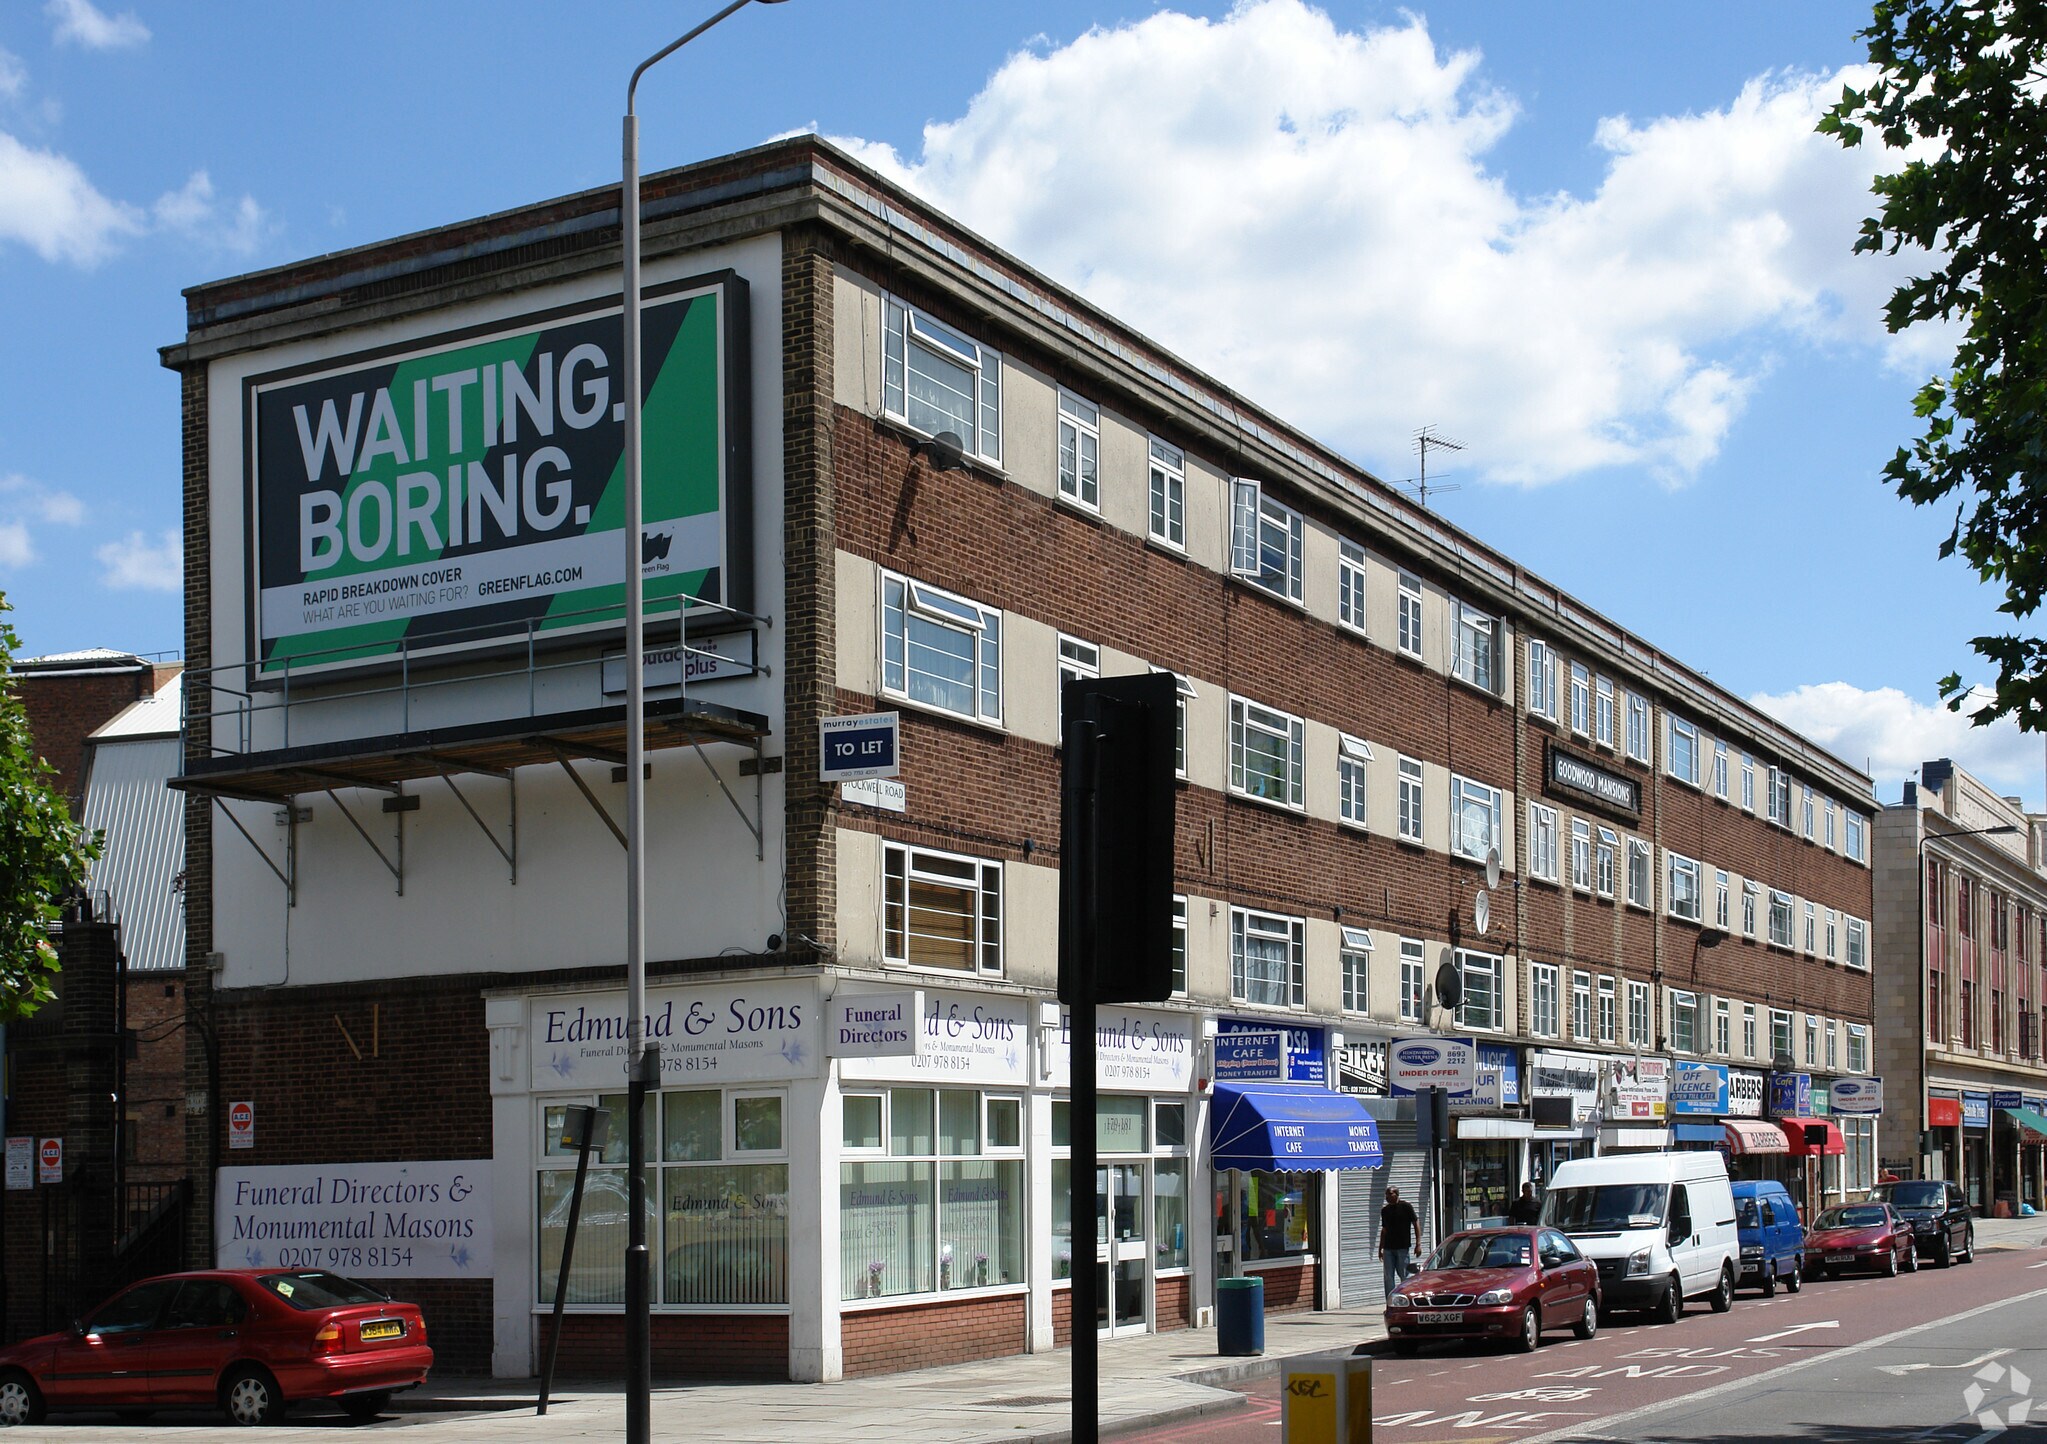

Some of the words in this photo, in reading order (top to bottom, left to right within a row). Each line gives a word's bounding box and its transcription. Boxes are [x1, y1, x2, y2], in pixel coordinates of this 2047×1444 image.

[292, 343, 625, 481] WAITING.
[300, 446, 590, 573] BORING.
[642, 565, 655, 573] reen
[656, 563, 670, 573] Flag
[303, 588, 338, 606] RAPID
[342, 575, 418, 599] BREAKDOWN
[422, 567, 462, 587] COVER
[478, 566, 583, 597] GREENFLAG.COM
[303, 607, 334, 624] WHAT
[337, 602, 360, 620] ARE
[363, 598, 385, 614] YOU
[388, 590, 436, 610] WAITING
[439, 585, 469, 603] FOR?
[684, 659, 717, 679] plus
[835, 743, 854, 756] TO
[862, 740, 883, 754] LET
[1558, 760, 1595, 789] GOODWOOD
[1598, 776, 1630, 802] MANSIONS
[885, 785, 904, 799] ROAD
[684, 1001, 715, 1035] &
[727, 998, 802, 1033] Sons
[845, 1004, 901, 1023] Funeral
[946, 1003, 966, 1037] &
[972, 1005, 1014, 1042] Sons
[839, 1027, 908, 1044] Directors
[1061, 1014, 1128, 1050] Eund
[1131, 1020, 1148, 1050] &
[1151, 1022, 1184, 1053] Sons
[671, 1039, 727, 1053] Monumental
[729, 1038, 764, 1050] Masons
[1216, 1036, 1277, 1047] INTERNET
[580, 1046, 613, 1058] Funeral
[1232, 1048, 1264, 1059] CAFE
[686, 1056, 718, 1072] 8154
[911, 1055, 931, 1068] 0207
[933, 1056, 949, 1069] 978
[950, 1057, 970, 1070] 8154
[1104, 1064, 1121, 1078] 0207
[1122, 1065, 1135, 1078] 978
[1135, 1065, 1150, 1079] 8154
[1244, 1069, 1278, 1077] TRANSFER
[1431, 1069, 1459, 1077] OFFER
[1683, 1072, 1702, 1081] OFF
[1674, 1082, 1711, 1092] LICENCE
[1775, 1076, 1793, 1087] Café
[1730, 1078, 1762, 1101] ARBERS
[1771, 1107, 1795, 1115] Kebab
[1274, 1126, 1305, 1137] INTERNET
[1348, 1126, 1371, 1137] MONEY
[1285, 1142, 1303, 1153] CAFE
[1348, 1141, 1379, 1152] TRANSFER
[235, 1177, 322, 1205] Funeral
[330, 1178, 440, 1204] Directors
[449, 1175, 473, 1202] &
[850, 1190, 887, 1206] Edmund
[888, 1189, 896, 1205] &
[899, 1189, 919, 1205] Sons
[948, 1188, 980, 1202] Edmund
[673, 1195, 729, 1211] Edmund
[734, 1194, 747, 1210] &
[752, 1193, 785, 1209] Sons
[233, 1211, 375, 1240] Monumental
[383, 1212, 474, 1238] Masons
[279, 1248, 323, 1267] 0207
[329, 1247, 362, 1267] 978
[368, 1247, 413, 1267] 8154
[1418, 1313, 1442, 1322] W622
[1444, 1313, 1461, 1322] XGF
[1614, 1346, 1800, 1359] BUS
[1531, 1365, 1731, 1378] AND
[1372, 1410, 1599, 1429] ANE
